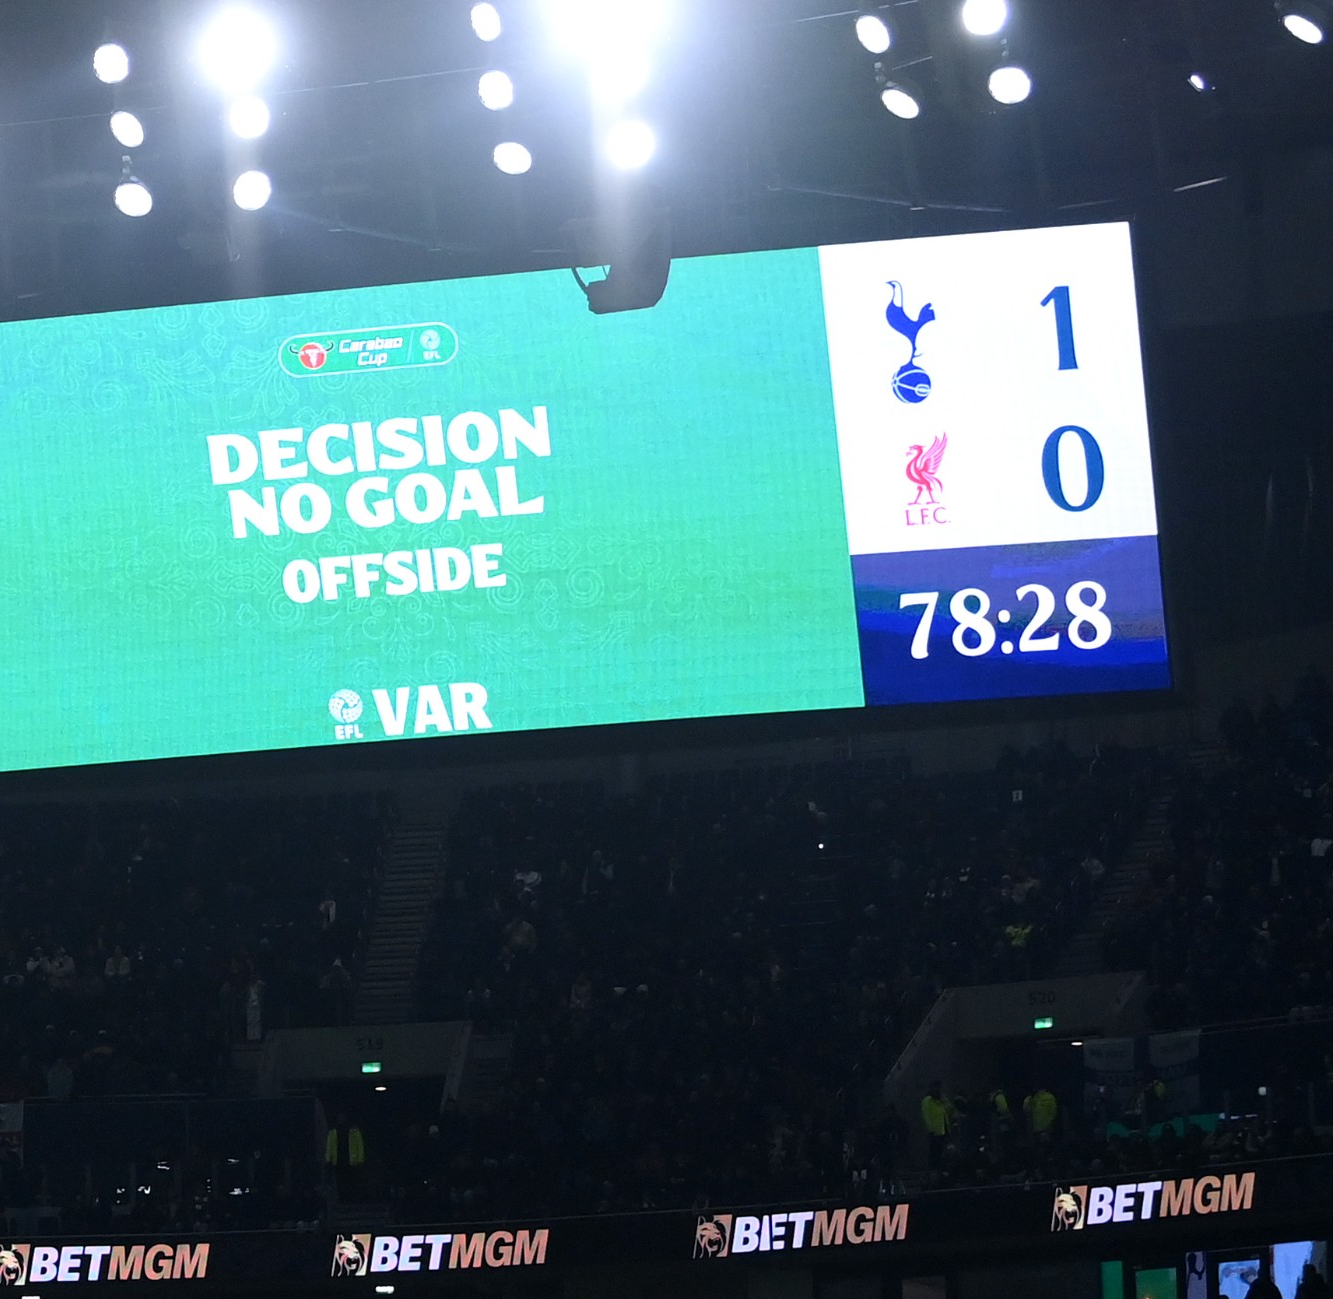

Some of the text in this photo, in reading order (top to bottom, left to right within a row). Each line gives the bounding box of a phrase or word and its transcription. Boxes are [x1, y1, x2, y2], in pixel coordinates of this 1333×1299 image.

[339, 336, 403, 353] Carabao
[1041, 286, 1078, 370] 1
[357, 351, 387, 366] Cup
[208, 406, 550, 486] DECISION
[1042, 426, 1104, 512] 0
[229, 463, 543, 538] NO GOAL
[284, 544, 506, 603] OFFSIDE
[901, 581, 1111, 658] 78:28
[335, 724, 363, 740] EFL
[372, 682, 493, 736] VAR
[1087, 1173, 1255, 1224] BETMGM
[371, 1230, 548, 1272] BETMGM
[732, 1204, 908, 1253] BETMGM
[29, 1244, 209, 1285] BETMGM
